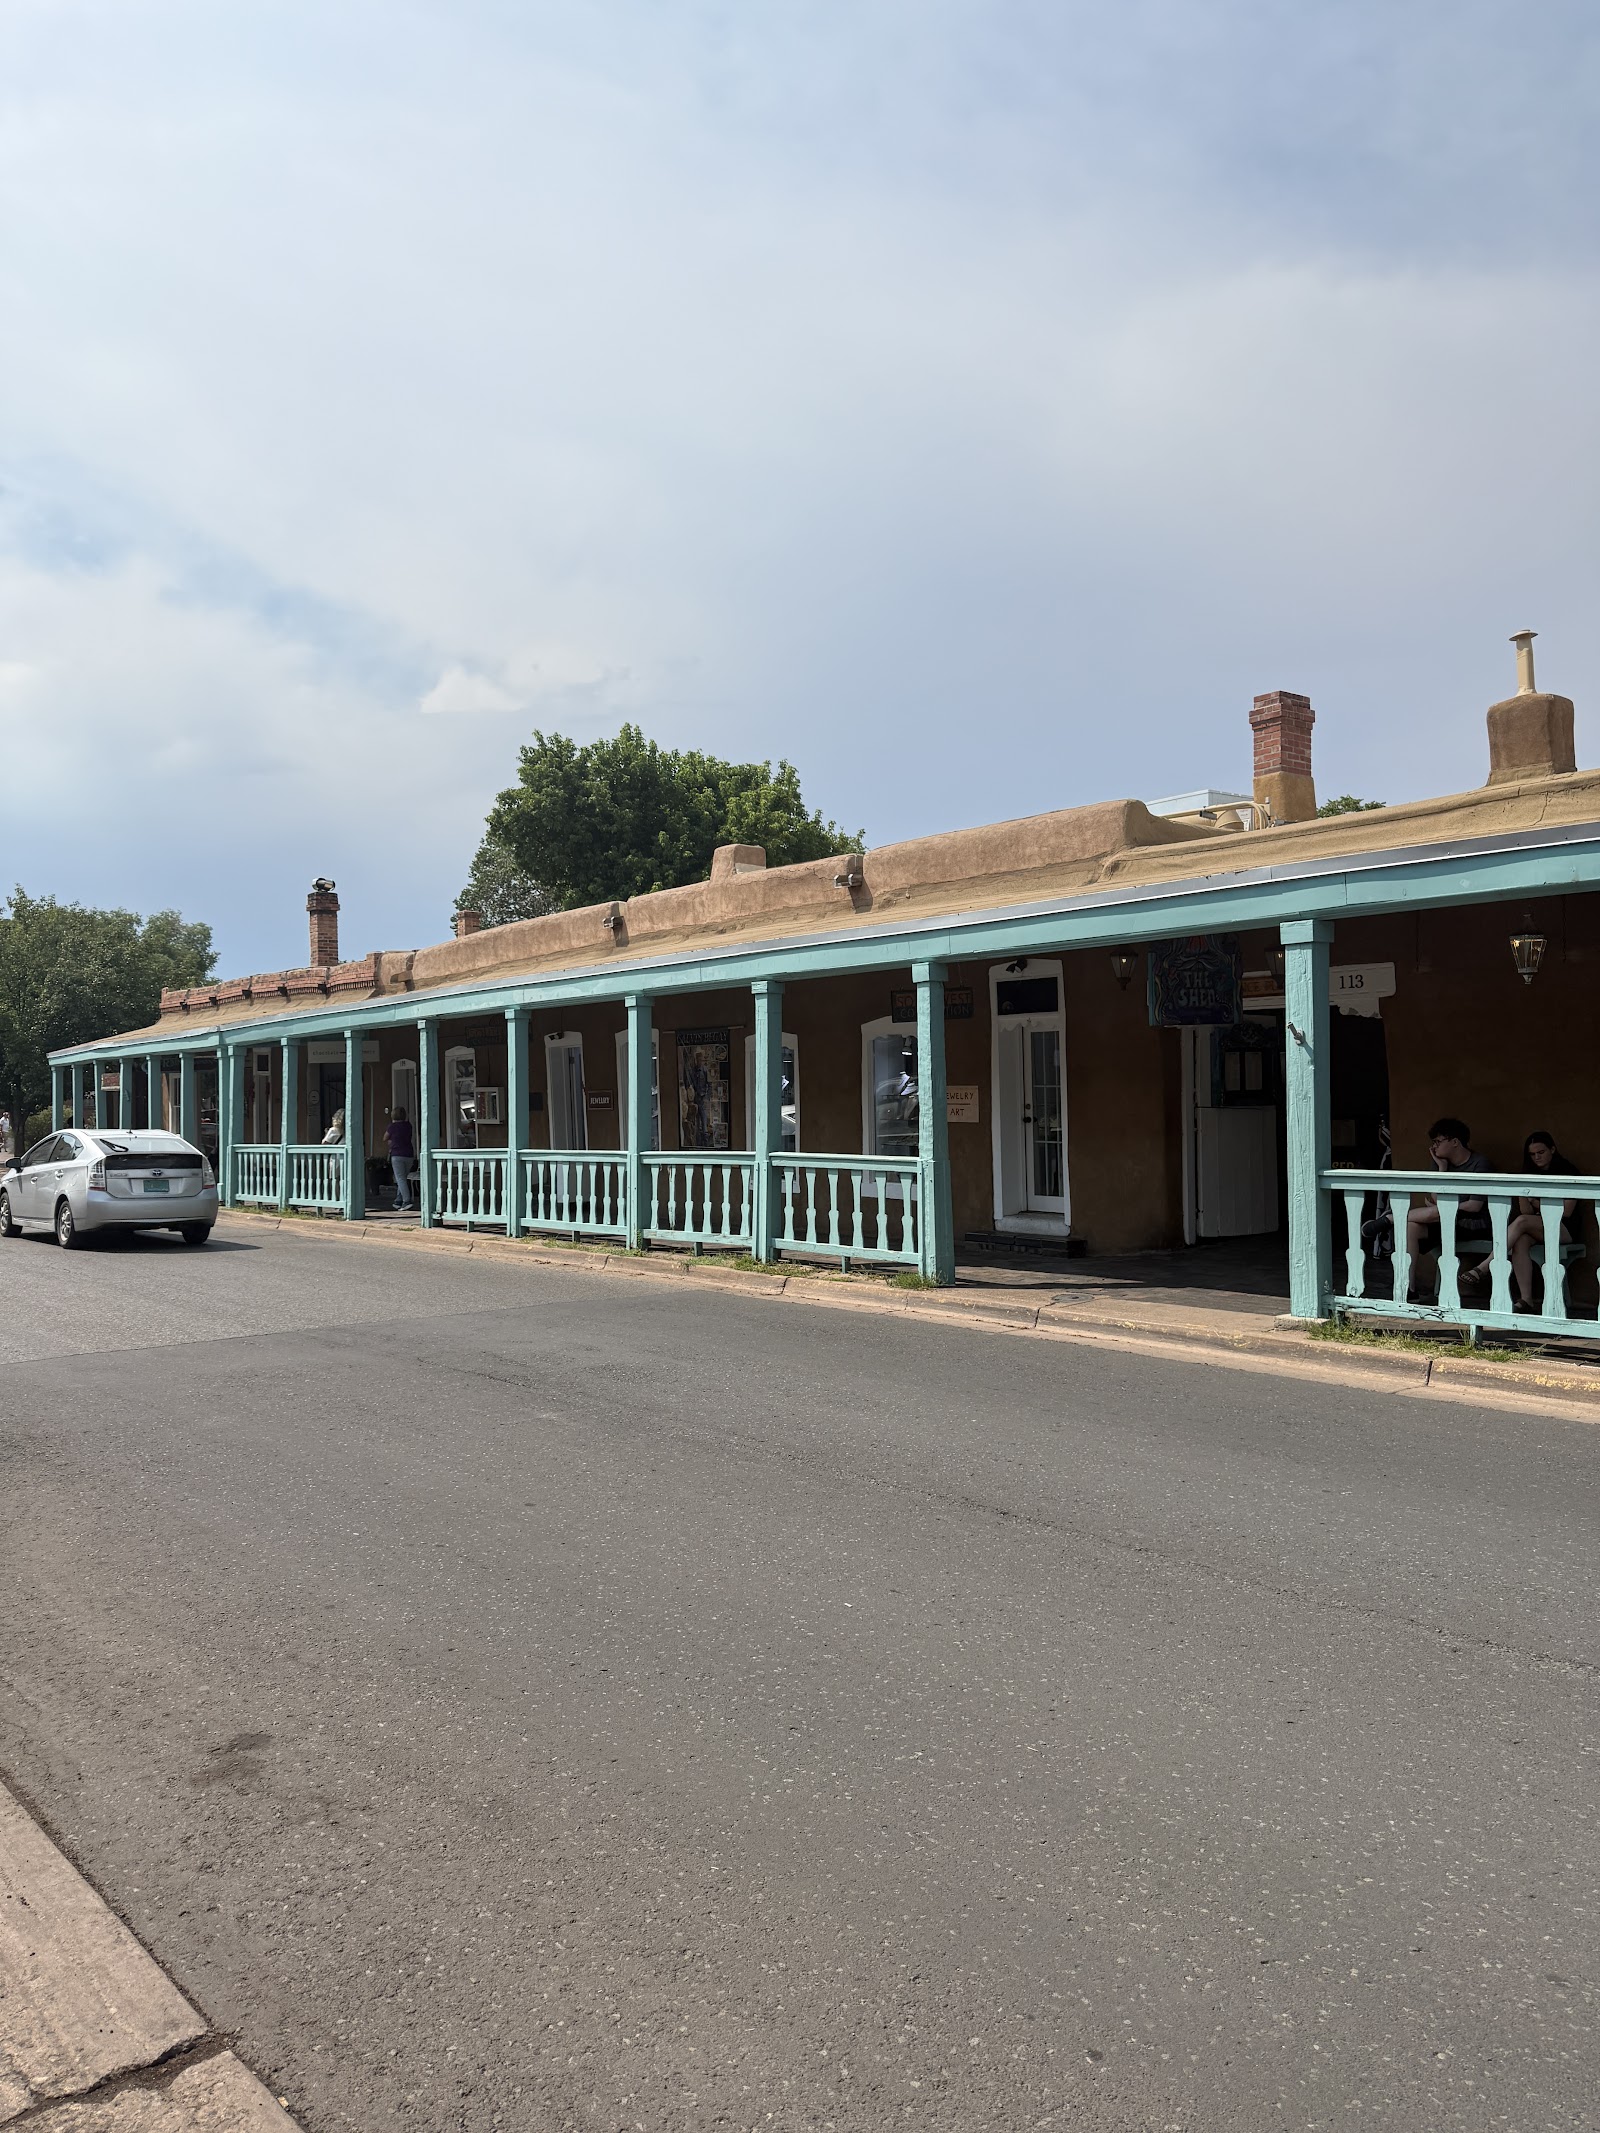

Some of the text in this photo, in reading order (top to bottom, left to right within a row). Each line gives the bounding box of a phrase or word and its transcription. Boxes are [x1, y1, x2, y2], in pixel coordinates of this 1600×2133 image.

[1183, 971, 1213, 988] THE
[1339, 974, 1364, 990] 113
[896, 992, 970, 1007] SOWEST
[1178, 988, 1216, 1008] SHED
[900, 1004, 970, 1019] COTION
[946, 1092, 973, 1100] EWELRY
[949, 1108, 965, 1116] ART
